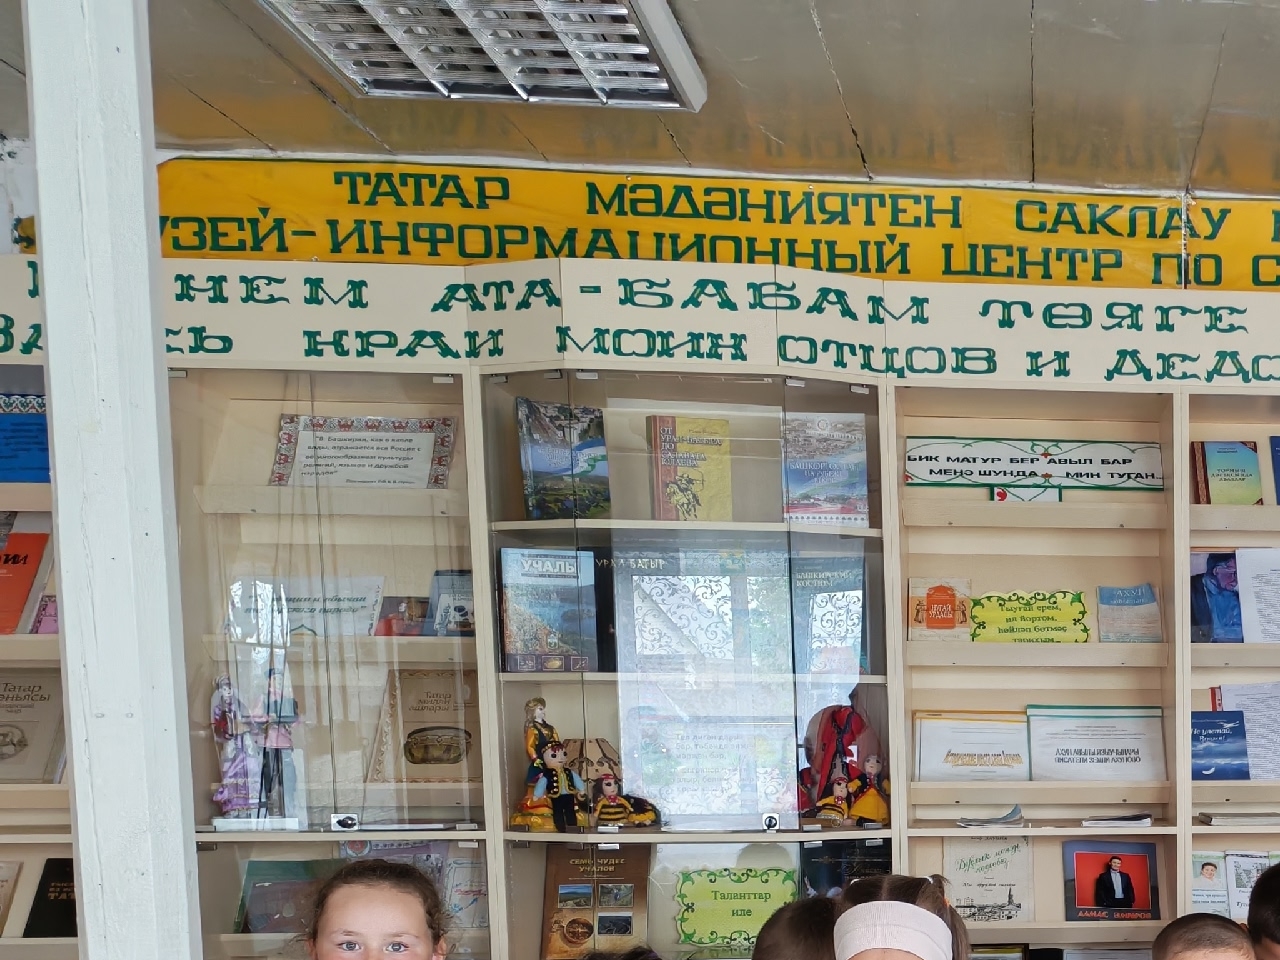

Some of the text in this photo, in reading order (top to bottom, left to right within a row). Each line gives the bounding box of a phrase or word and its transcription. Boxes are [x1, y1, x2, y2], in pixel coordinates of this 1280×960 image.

[333, 173, 510, 209] ТАТАР
[586, 183, 962, 229] МӘДӘНИЯТЕН
[1015, 199, 1232, 241] САКЛАУ
[942, 243, 1123, 282] ЦЕНТР
[1152, 252, 1222, 287] ПО
[978, 299, 1249, 335] ТӨЯГЕ
[555, 325, 748, 362] МОИХ
[777, 334, 998, 379] ОТЦОВ
[1026, 350, 1071, 377] И
[946, 456, 1001, 464] МАТУР
[1010, 457, 1040, 465] БЕР
[1047, 457, 1093, 466] АВЫЛ
[1101, 458, 1133, 466] БАР
[1066, 471, 1101, 479] МИН
[2, 682, 41, 693] Татар
[711, 889, 771, 901] Таланттар
[731, 909, 752, 917] иле
